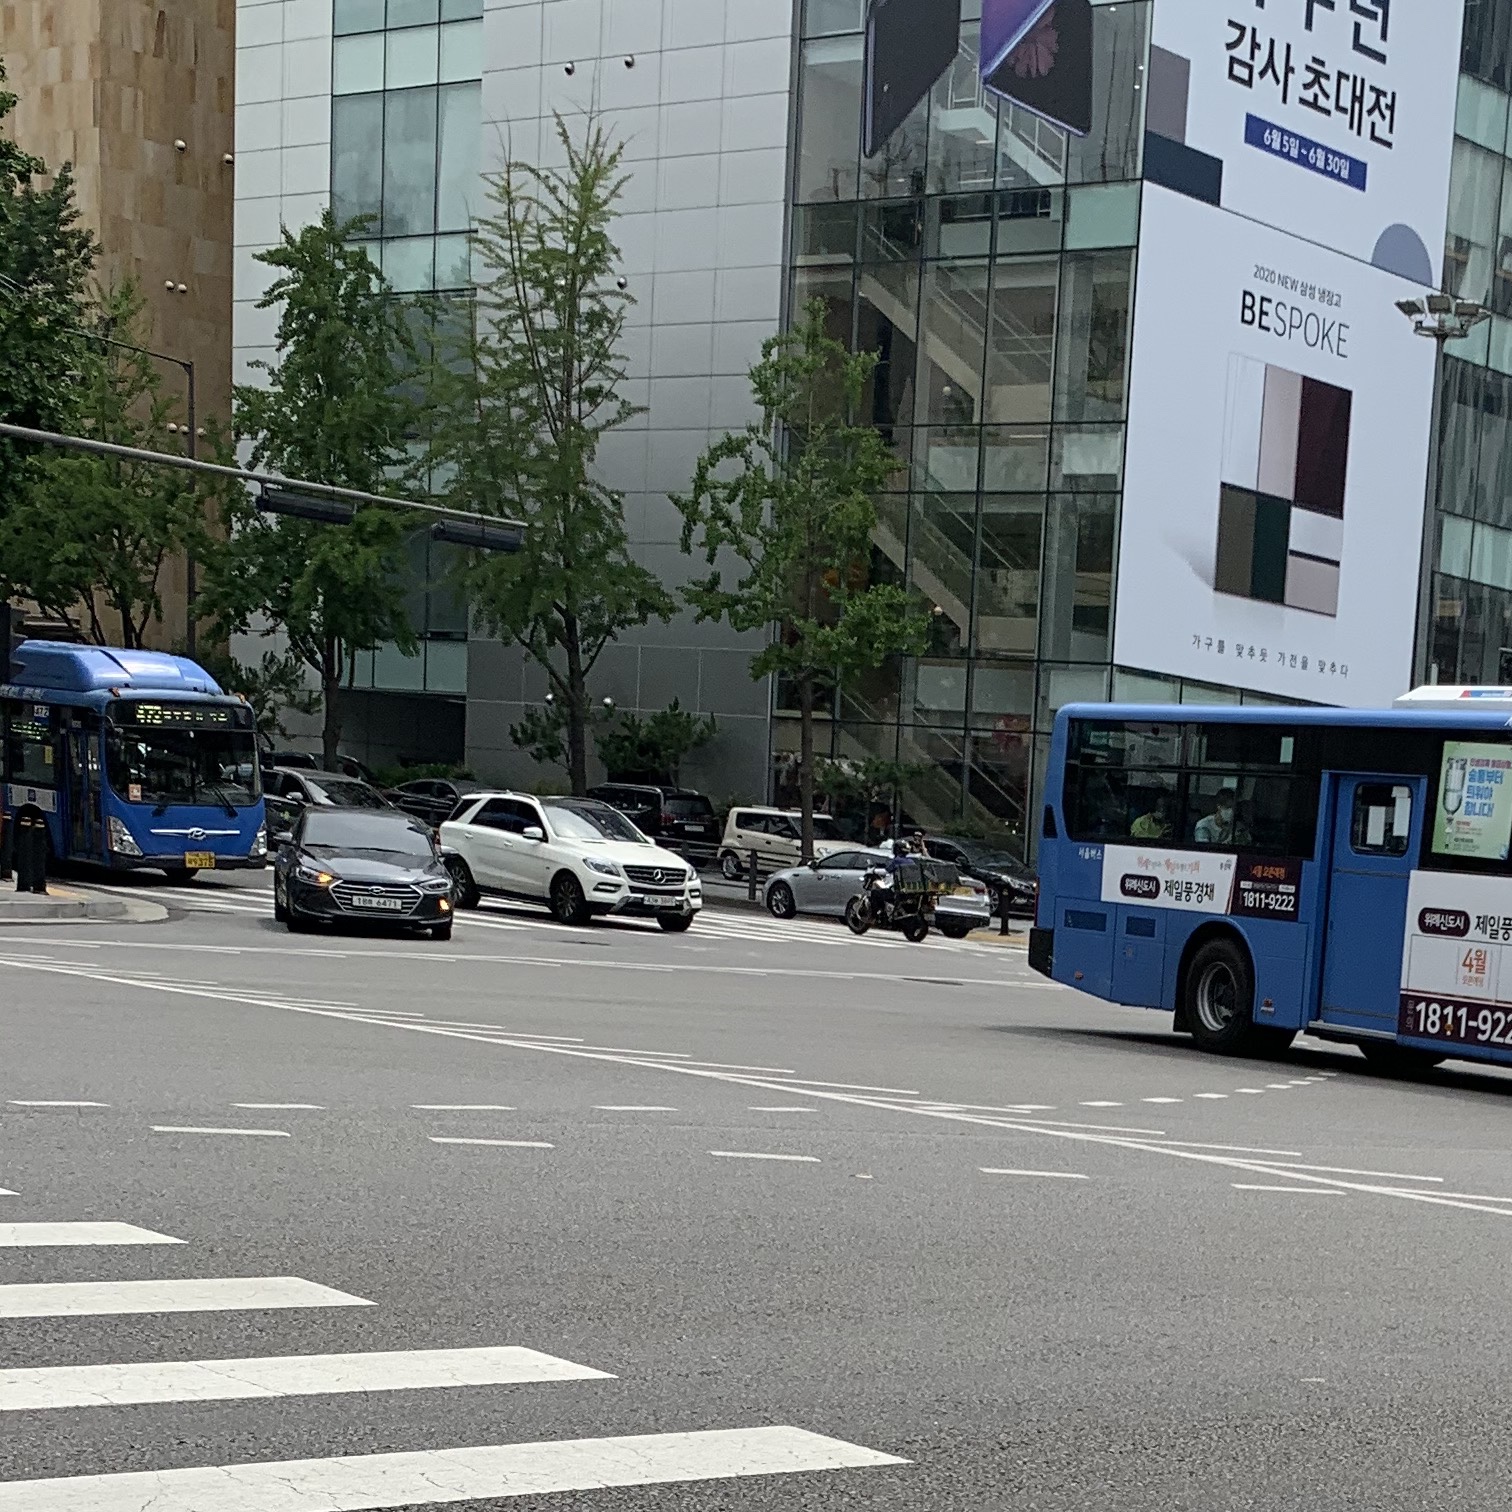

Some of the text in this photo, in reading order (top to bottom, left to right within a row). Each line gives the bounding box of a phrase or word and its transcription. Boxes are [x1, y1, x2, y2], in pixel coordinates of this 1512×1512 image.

[1225, 18, 1295, 105] 감사
[1298, 56, 1396, 150] 초대전
[1263, 128, 1282, 151] 6월
[1282, 135, 1300, 159] 5일
[1308, 147, 1326, 170] 6월
[1326, 153, 1350, 180] 30일
[1253, 264, 1341, 308] 2020 NEW 삼성 냉장고
[1240, 289, 1350, 359] BESPOKE
[1192, 634, 1349, 678] 가구를 맞추듯 가전을 맞추다
[1163, 879, 1215, 904] 제일풍경채
[1242, 890, 1295, 912] 1811-9222
[1424, 912, 1465, 930] 위례신도시
[1461, 948, 1486, 975] 4월
